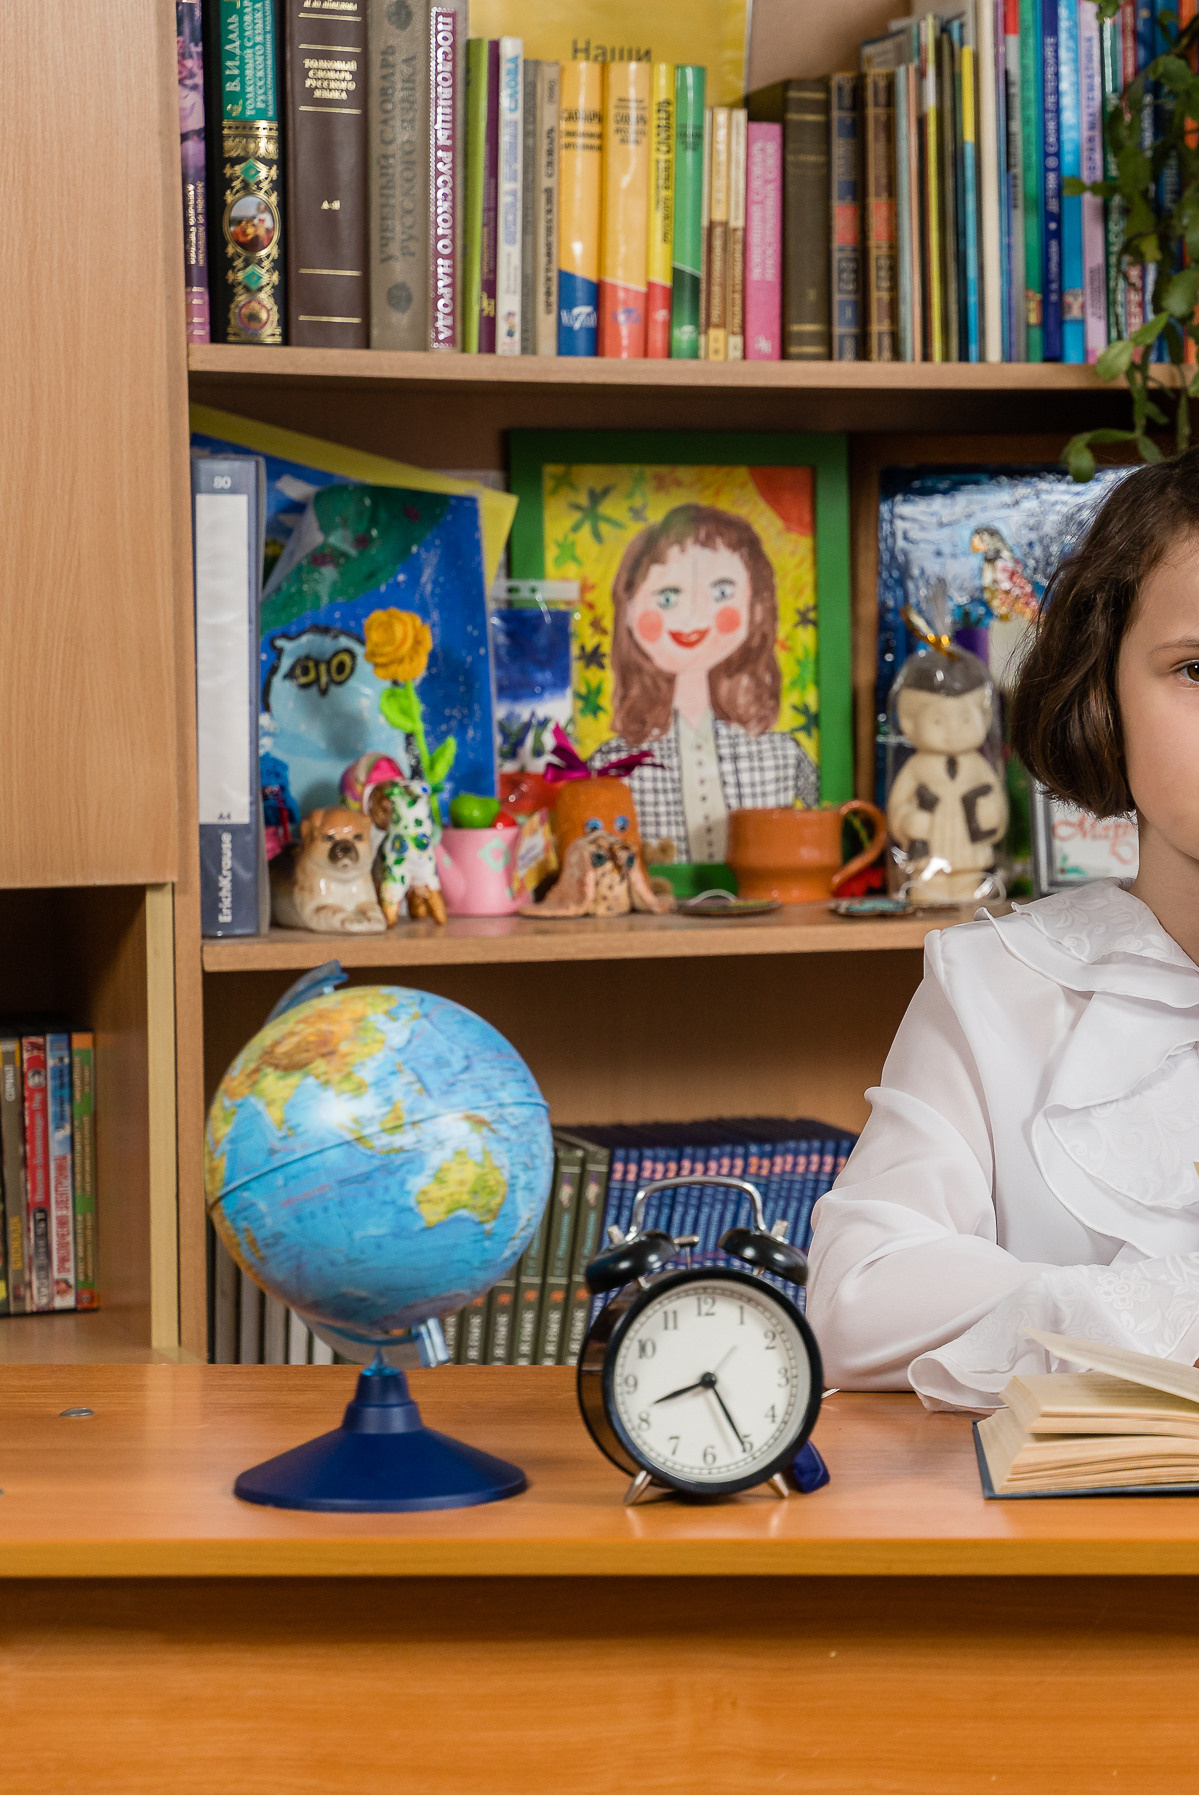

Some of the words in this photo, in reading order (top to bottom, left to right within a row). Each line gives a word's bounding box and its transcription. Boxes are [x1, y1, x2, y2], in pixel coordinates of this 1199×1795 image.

[253, 2, 266, 43] ЯЗЫКА
[303, 59, 357, 71] ТОЛКОВЫЙ
[572, 38, 651, 63] Наши
[243, 48, 257, 117] ТОЛКОВЫЙ
[254, 44, 267, 109] РУССКОГО
[305, 78, 356, 91] РУССКОГО
[308, 69, 353, 80] СЛОВАРЬ
[313, 89, 347, 100] ЯЗЫКА
[400, 53, 418, 136] ЯЗЫКА
[434, 15, 454, 146] ПОСЛОВИЦЫ
[503, 55, 519, 114] СЛОВА
[1083, 35, 1097, 132] МАТЕМАТИКА
[378, 44, 397, 147] СЛОВАРЬ
[1044, 35, 1058, 155] САНКТ-ПЕТЕРБУРГЕ
[544, 127, 557, 179] СЛОВАРЬ
[751, 140, 763, 202] СЛОВАРЬ
[765, 140, 777, 180] СЛОВ
[1044, 155, 1058, 169] О
[378, 149, 398, 266] УЧЕБНЫЙ
[400, 141, 418, 258] РУССКОГО
[436, 149, 454, 255] РУССКОГО
[1045, 171, 1060, 215] ДЕТЯМ
[751, 203, 762, 281] НОВЕЙШИЙ
[764, 182, 776, 281] ИНОСТРАННЫХ
[434, 257, 454, 341] НАРОДА
[213, 476, 232, 489] 80
[217, 831, 233, 924] ErichKrause
[662, 1309, 679, 1331] 11
[696, 1297, 717, 1317] 12
[738, 1305, 747, 1326] 1
[638, 1338, 657, 1360] 10
[764, 1330, 777, 1351] 2
[624, 1373, 638, 1395] 9
[777, 1368, 789, 1389] 3
[637, 1411, 651, 1431] 8
[764, 1404, 779, 1425] 4
[667, 1435, 681, 1456] 7
[703, 1445, 717, 1466] 6
